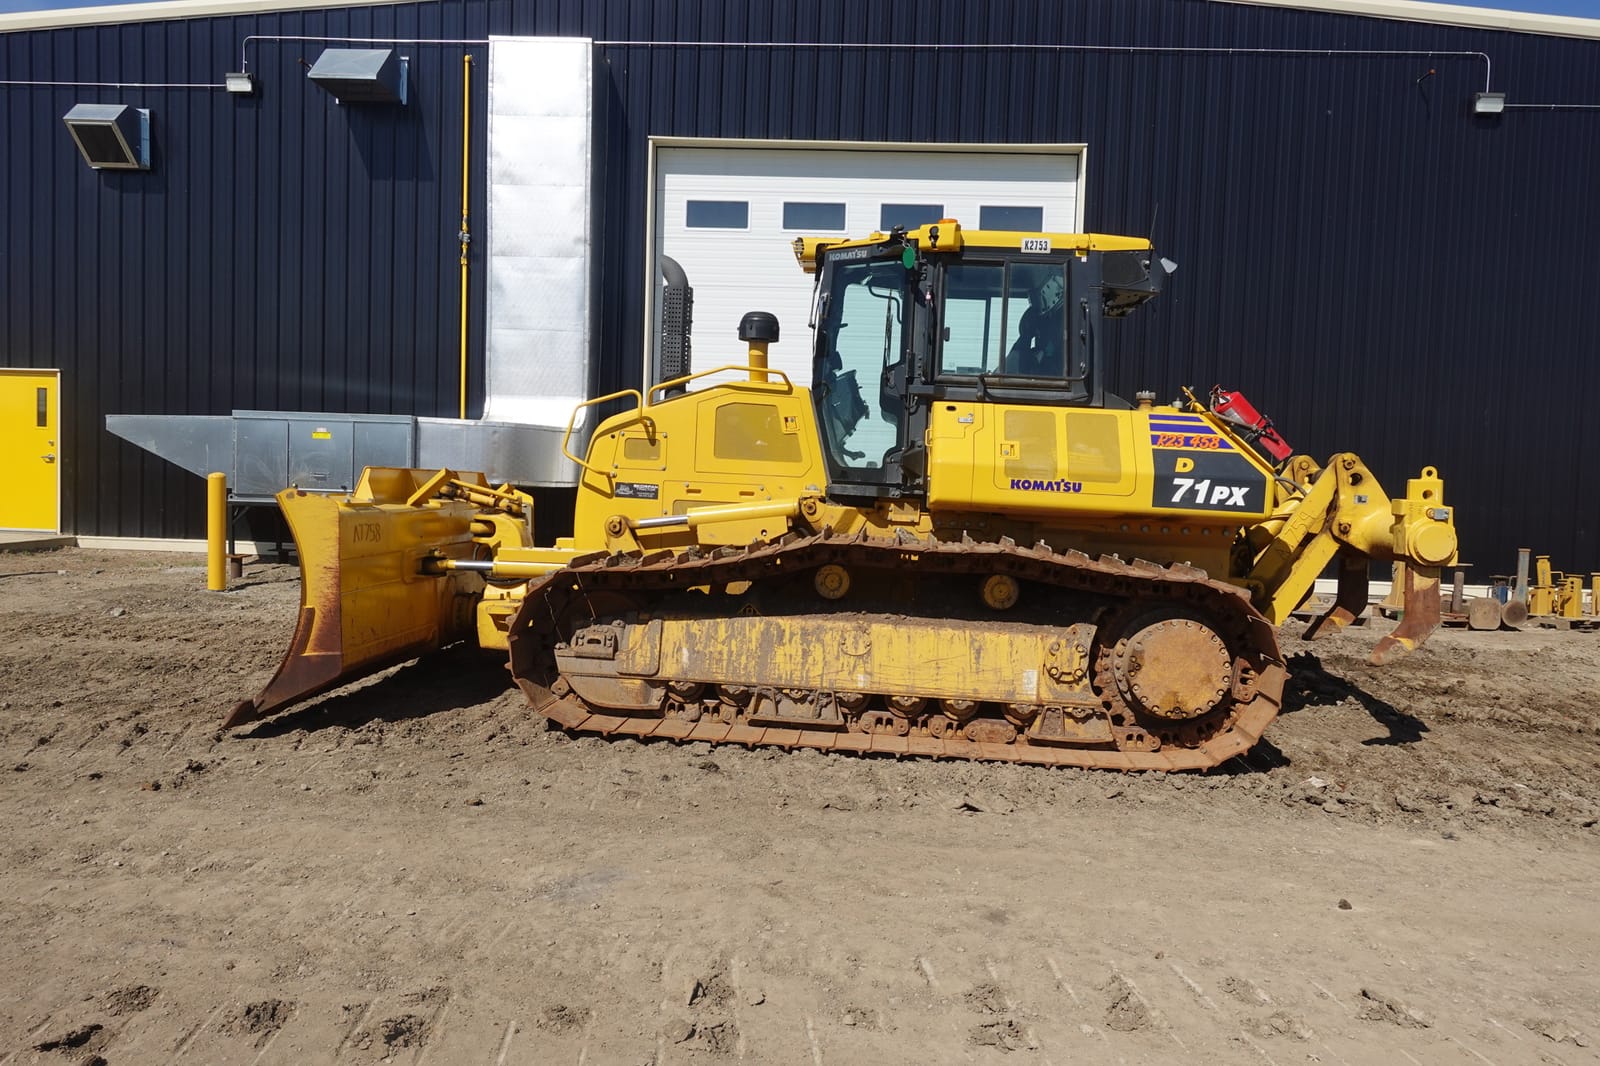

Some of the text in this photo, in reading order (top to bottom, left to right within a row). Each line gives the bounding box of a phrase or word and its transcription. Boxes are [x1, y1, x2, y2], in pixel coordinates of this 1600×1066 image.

[1024, 239, 1048, 251] K2753
[829, 250, 867, 260] KOMATSU
[1189, 434, 1220, 450] 458
[1175, 457, 1195, 473] D
[1009, 478, 1082, 493] KOMATSU
